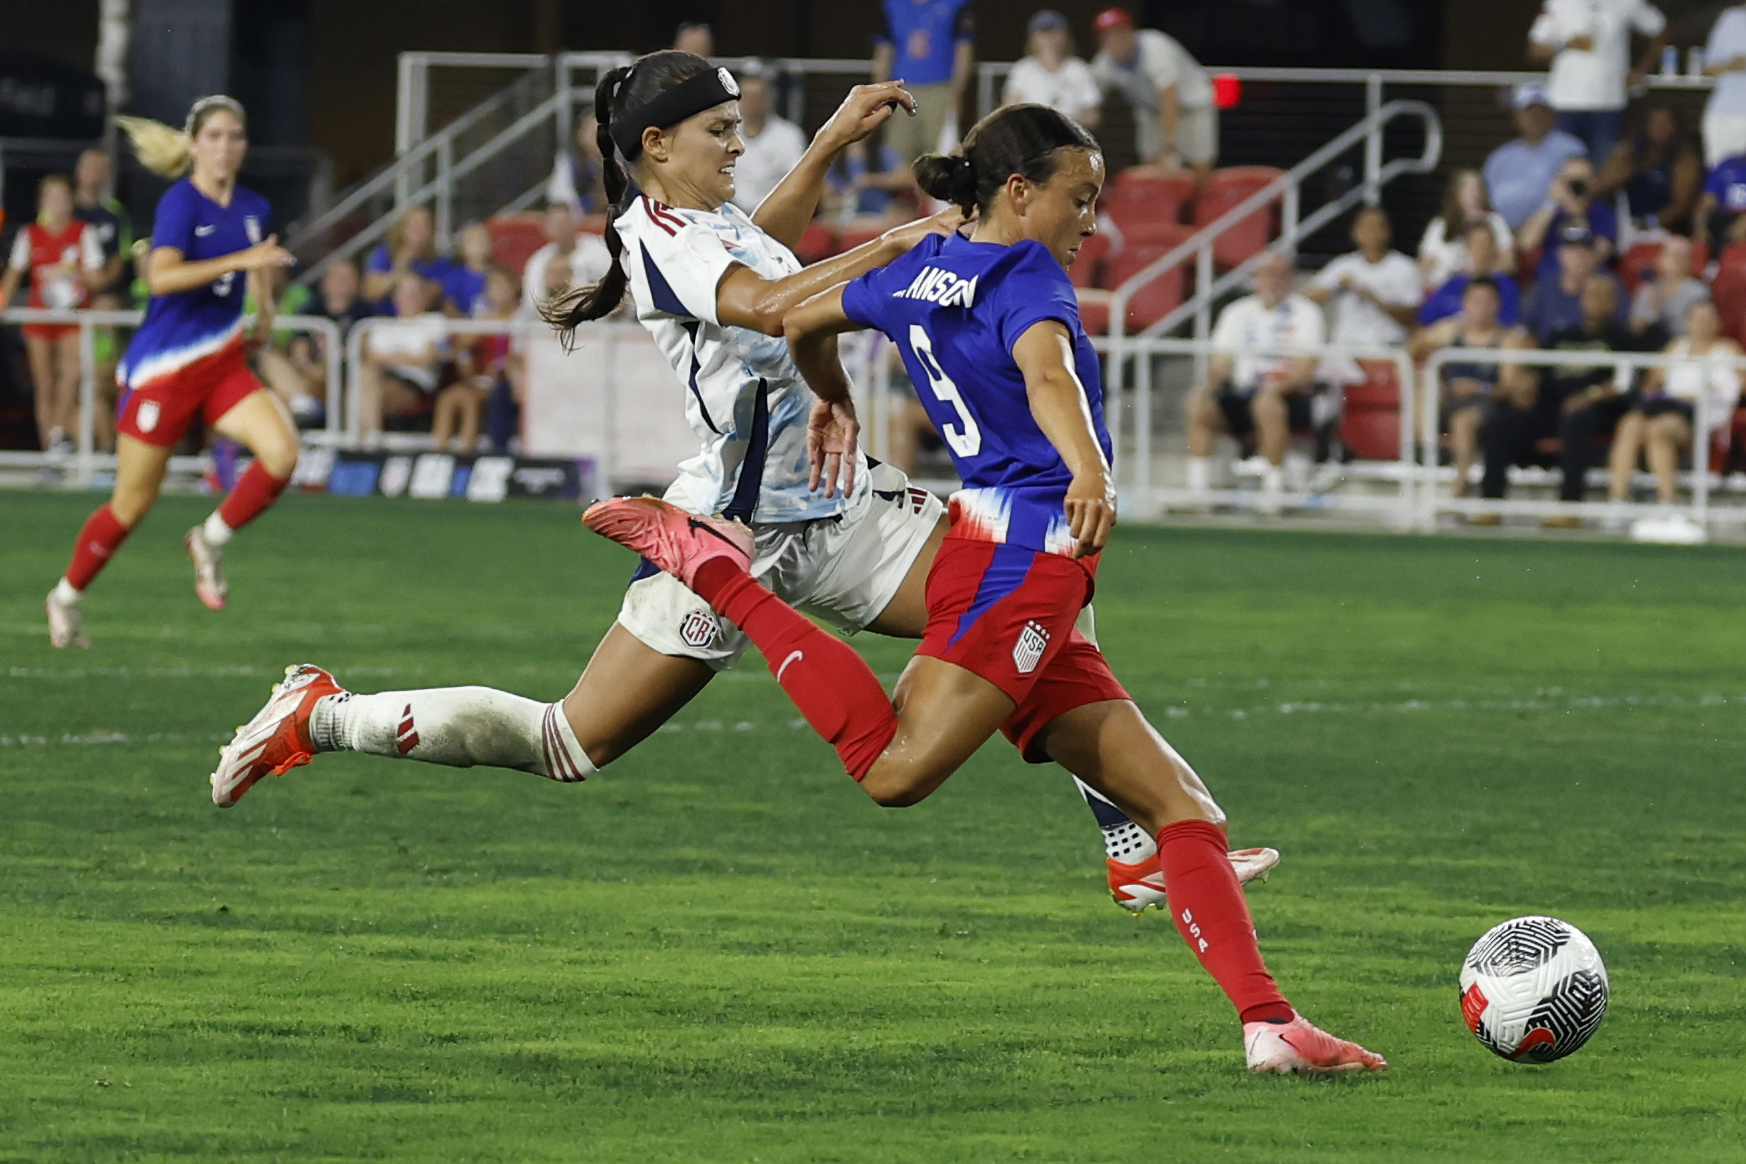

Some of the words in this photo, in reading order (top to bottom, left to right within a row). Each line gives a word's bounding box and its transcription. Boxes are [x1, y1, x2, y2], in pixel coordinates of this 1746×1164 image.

[892, 265, 979, 309] ANSON
[909, 323, 981, 458] 9
[1023, 629, 1044, 652] USA
[1181, 907, 1209, 953] USA
